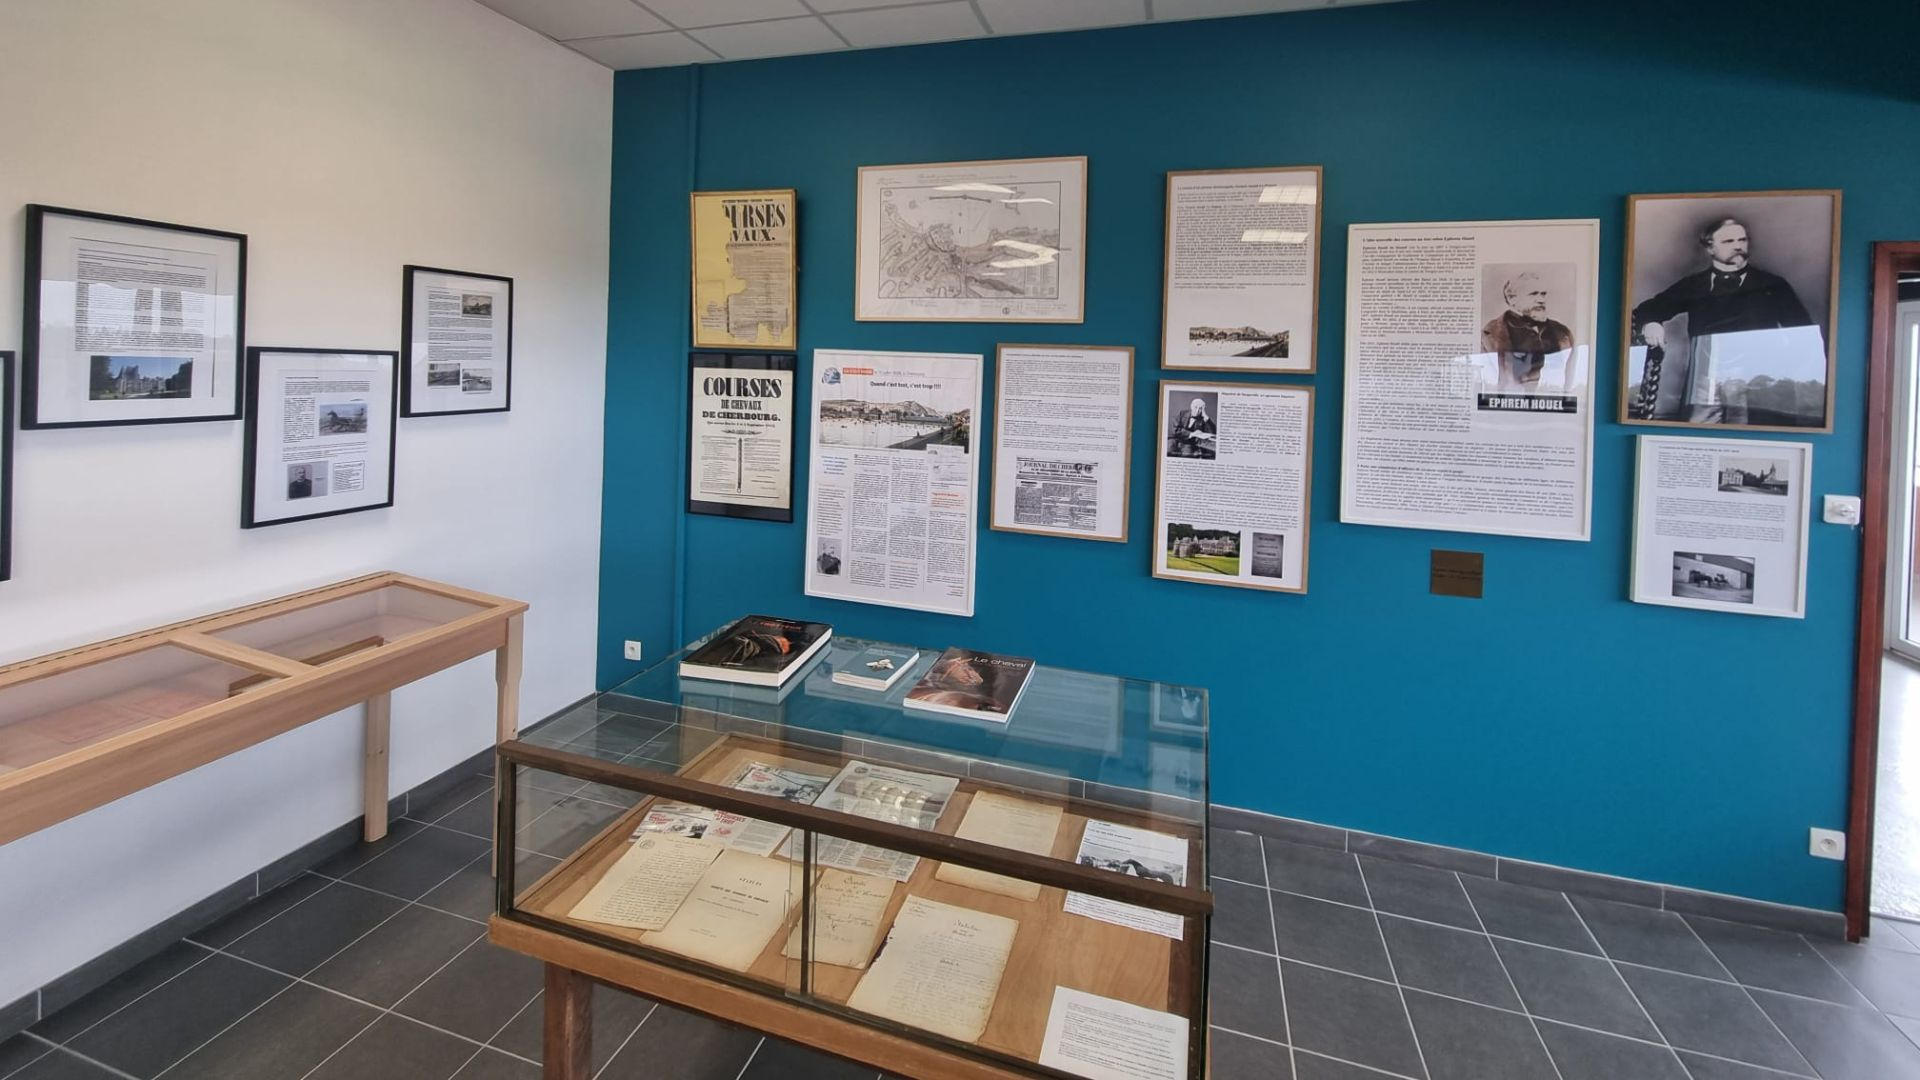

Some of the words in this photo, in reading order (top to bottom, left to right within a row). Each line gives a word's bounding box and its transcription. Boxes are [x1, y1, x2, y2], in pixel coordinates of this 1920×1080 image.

[730, 229, 776, 242] VAUX.
[703, 376, 782, 399] COURSES
[720, 399, 730, 409] DE
[731, 400, 762, 411] CHEVAUX
[1489, 397, 1529, 409] EPHREM
[1531, 399, 1564, 410] HOUEL
[702, 410, 716, 419] DE
[717, 411, 781, 422] CHERBOURG.
[974, 656, 989, 664] Le
[990, 658, 1027, 669] cheval
